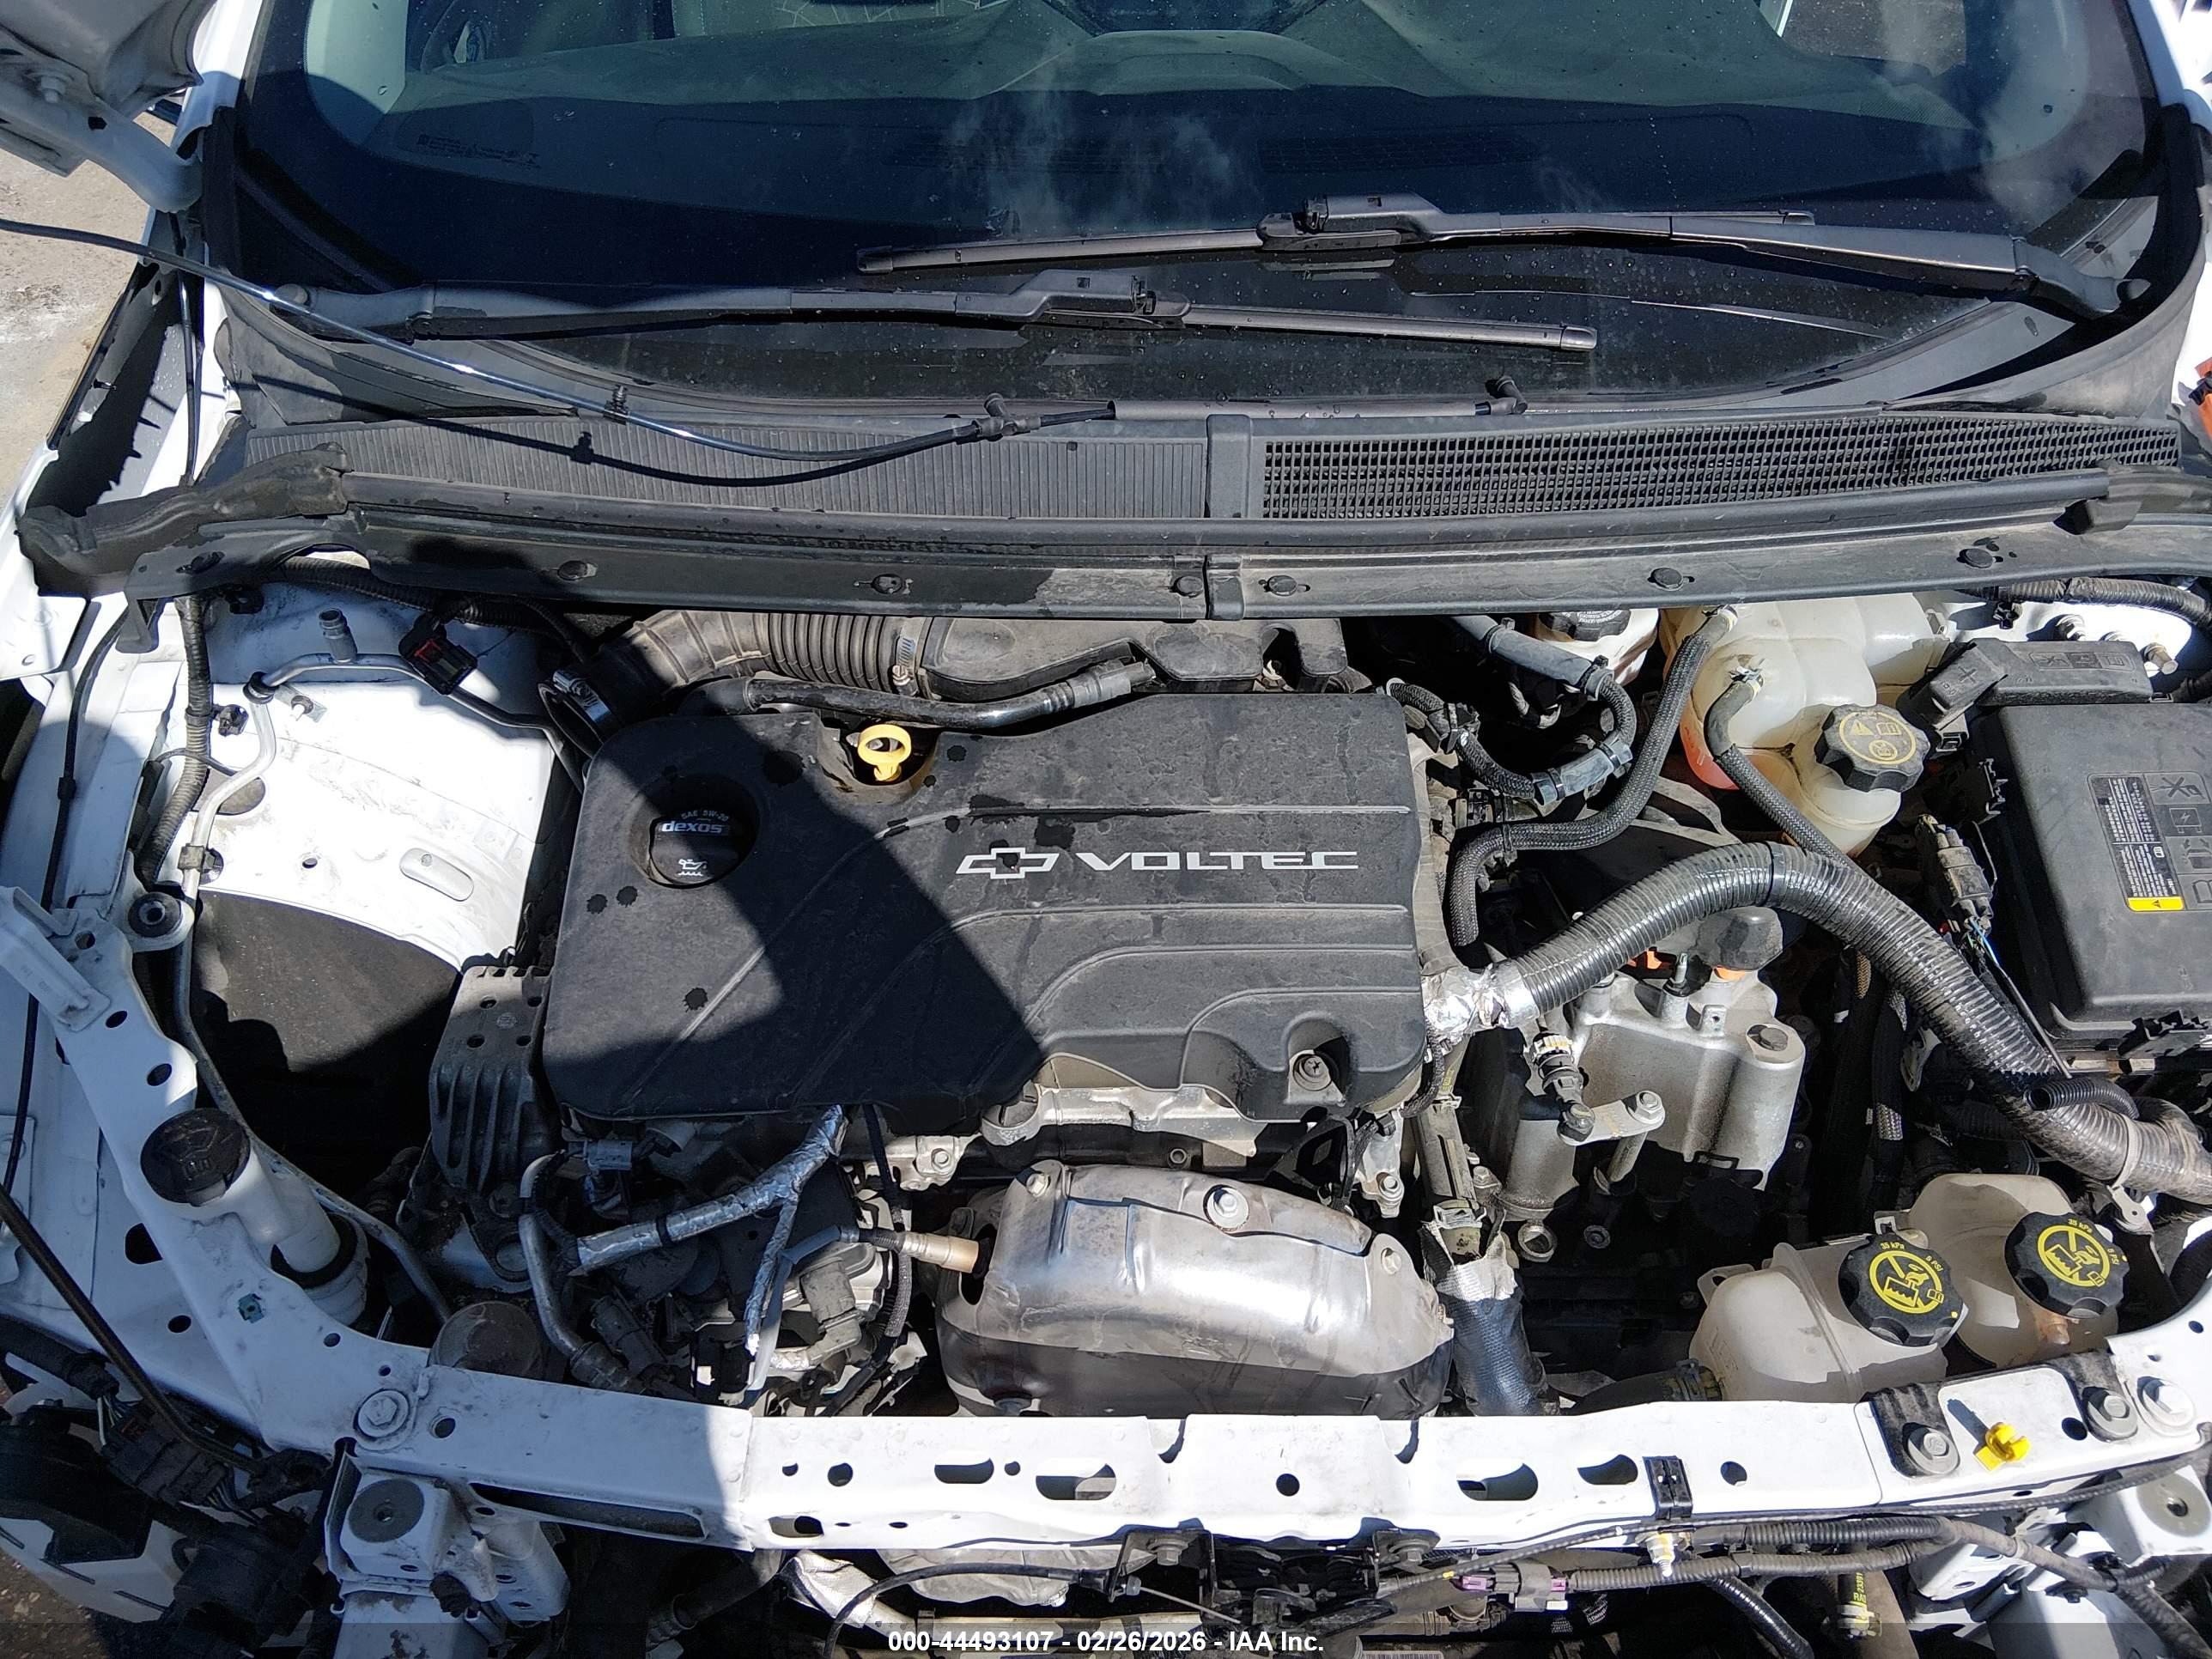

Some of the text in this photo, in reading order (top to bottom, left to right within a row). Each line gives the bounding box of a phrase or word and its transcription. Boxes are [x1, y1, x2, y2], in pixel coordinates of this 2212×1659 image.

[681, 811, 698, 819] SAE
[662, 820, 723, 833] dexos
[1075, 851, 1358, 871] VOLTEC
[1881, 1242, 1890, 1250] 35
[1931, 1260, 1944, 1272] PSI
